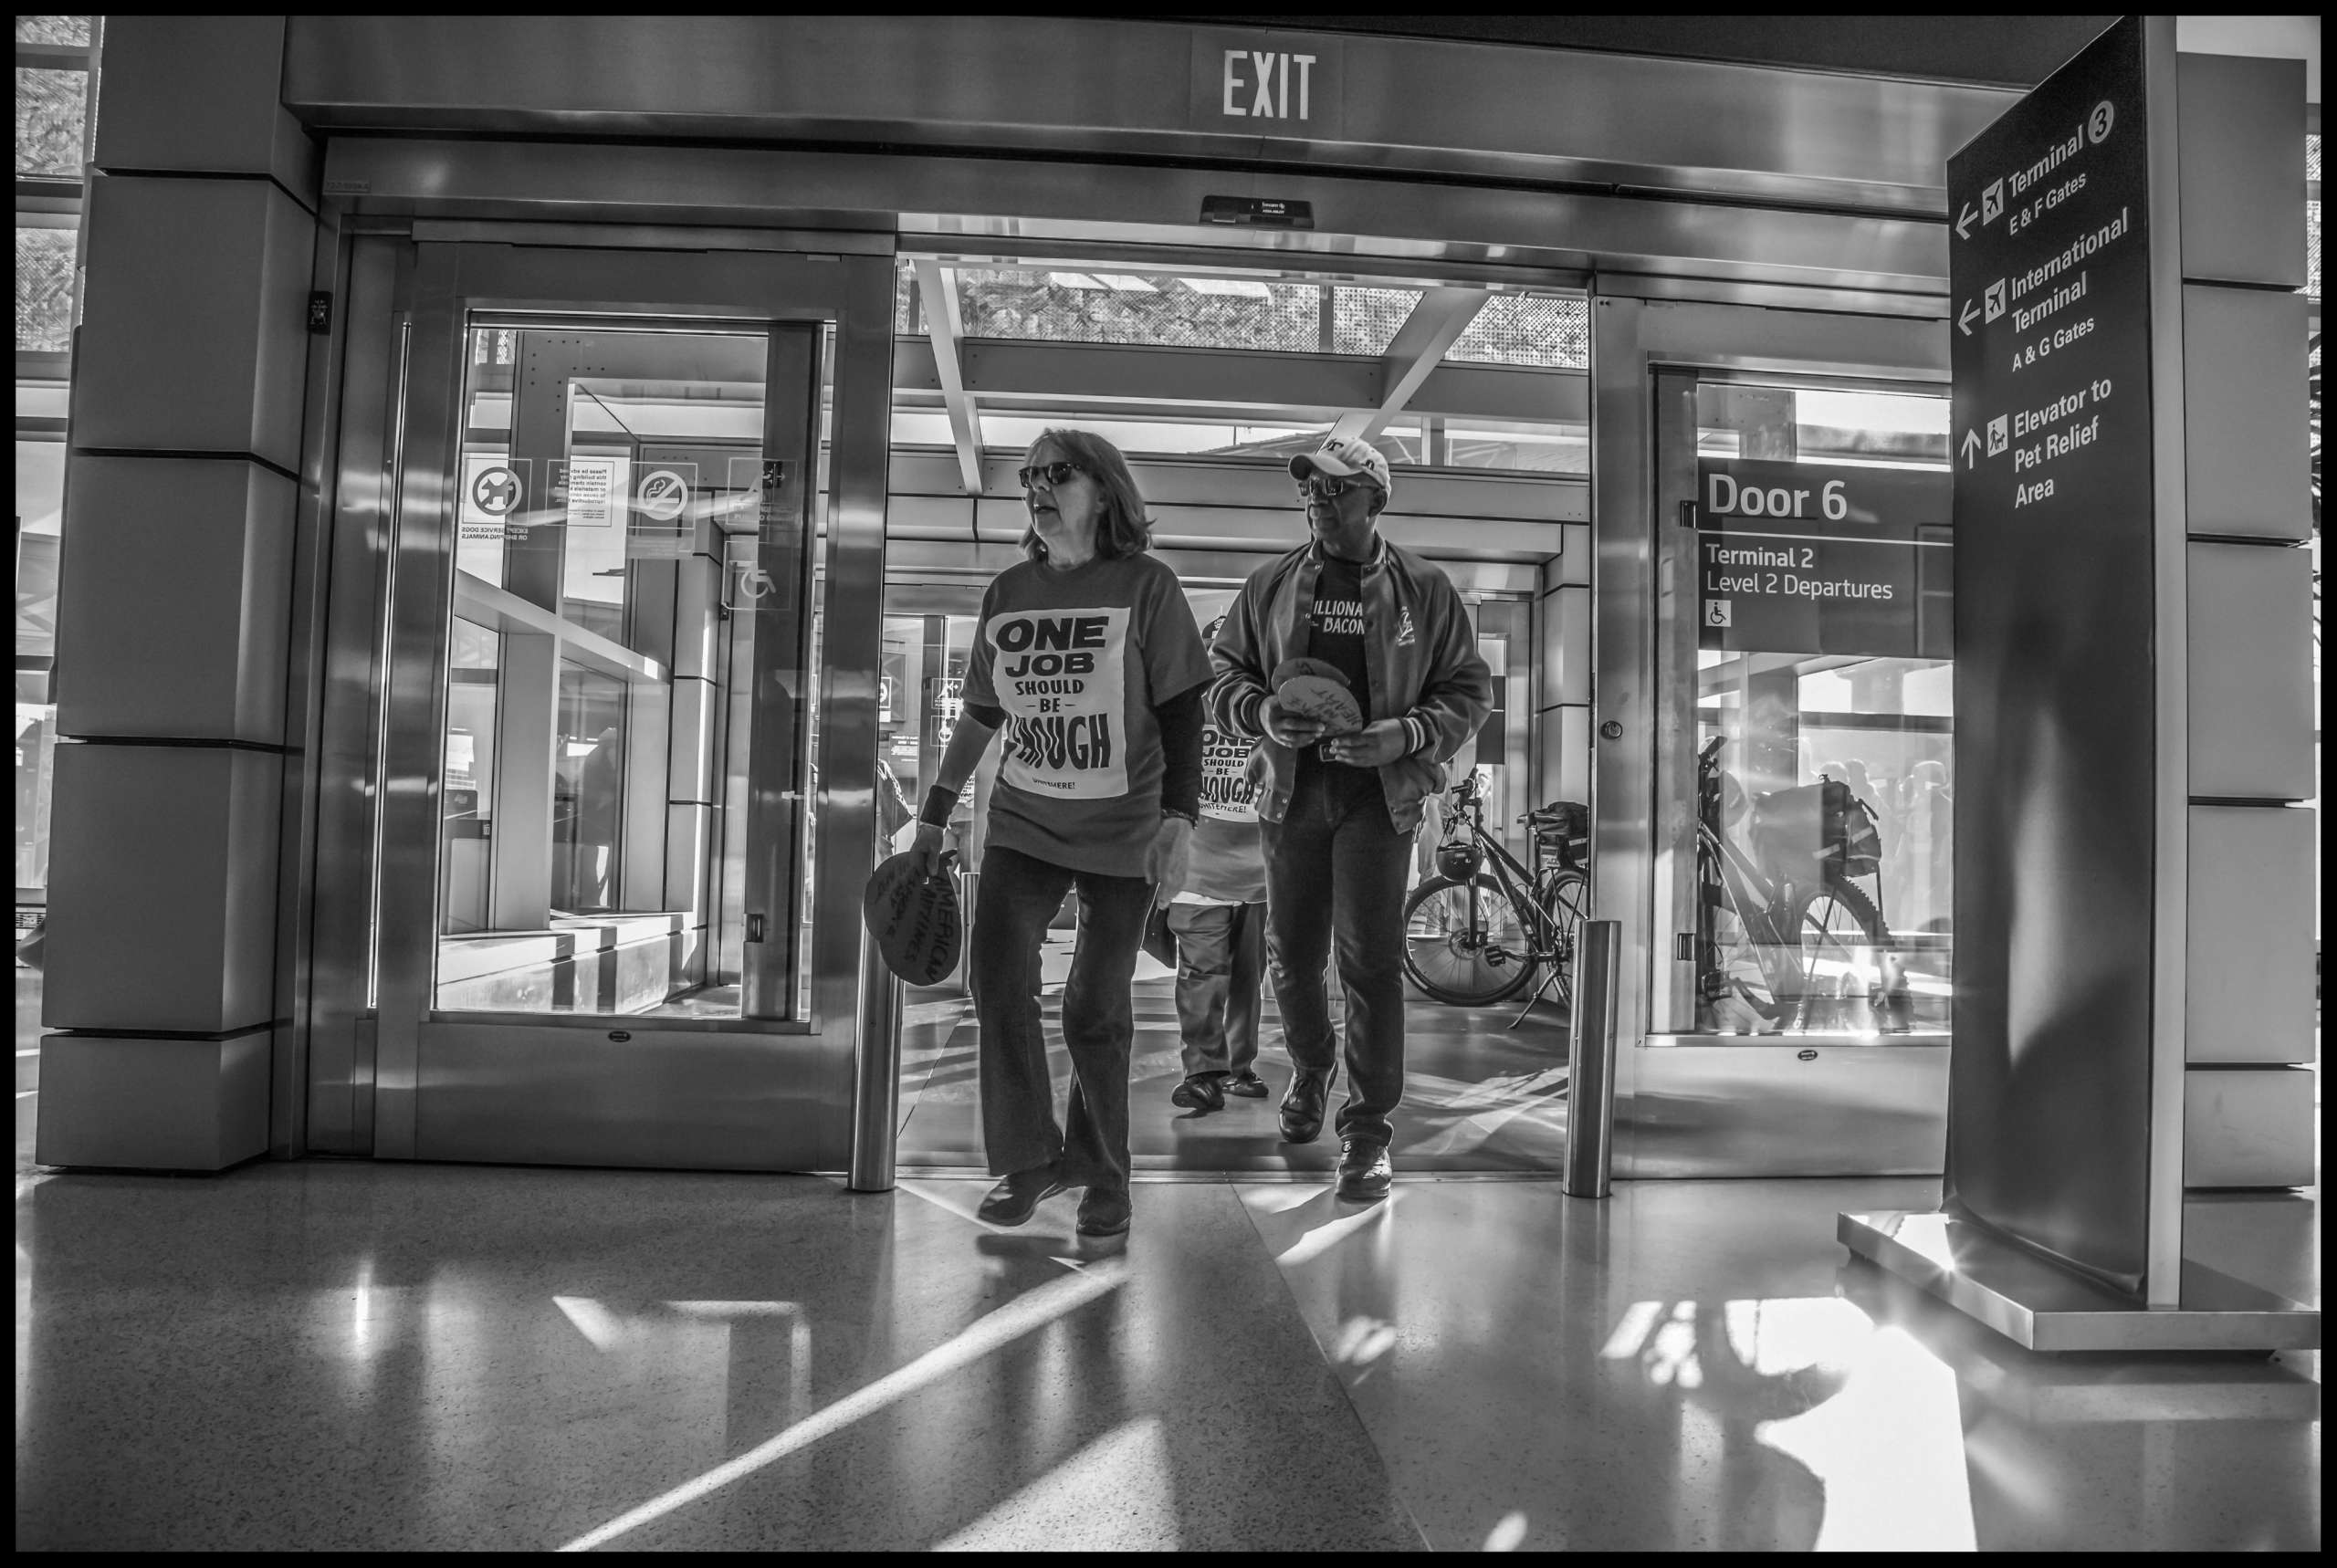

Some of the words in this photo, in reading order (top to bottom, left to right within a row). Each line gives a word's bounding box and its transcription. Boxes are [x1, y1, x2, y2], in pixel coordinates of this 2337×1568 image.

[1223, 50, 1316, 120] EXIT
[2008, 125, 2083, 198] Terminal
[2093, 108, 2108, 137] 3
[2009, 216, 2017, 235] E
[2020, 209, 2032, 228] &
[2034, 201, 2044, 220] F
[2046, 172, 2087, 211] Gates
[2011, 206, 2129, 301] International
[2012, 272, 2087, 334] Terminal
[2012, 353, 2022, 372] A
[2025, 345, 2037, 363] &
[2039, 337, 2050, 357] G
[2054, 318, 2094, 350] Gates
[2015, 389, 2086, 438] Elevator
[2091, 378, 2112, 402] to
[2015, 444, 2041, 473] Pet
[2047, 416, 2100, 461] Relief
[1709, 474, 1809, 517] Door
[1822, 480, 1848, 520] 6
[2015, 479, 2054, 508] Area
[1706, 544, 1795, 568] Terminal
[1800, 549, 1813, 568] 2
[1707, 571, 1759, 593] Level
[1766, 573, 1777, 594] 2
[1784, 575, 1892, 601] Departures
[996, 616, 1110, 652] ONE
[1005, 653, 1095, 677] JOB
[1015, 680, 1085, 695] SHOULD
[1040, 697, 1060, 713] BE
[1203, 730, 1257, 746] ONE
[1203, 747, 1251, 758] JOB
[1199, 777, 1255, 804] NOUGH
[925, 875, 955, 984] AMERICAN
